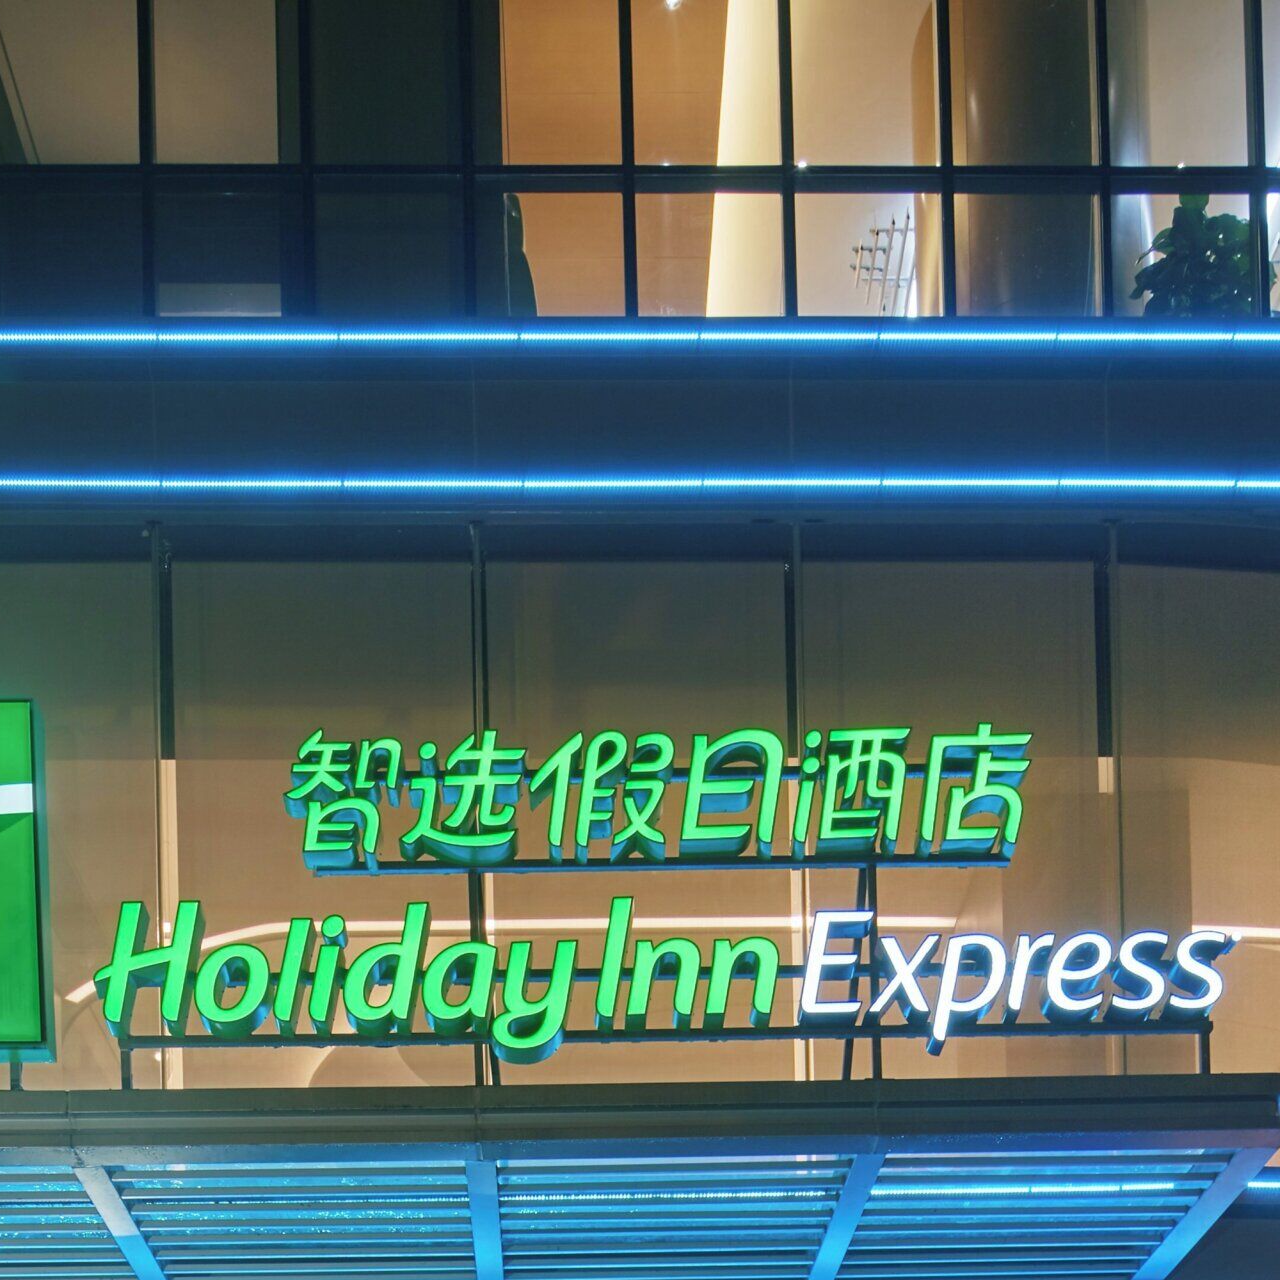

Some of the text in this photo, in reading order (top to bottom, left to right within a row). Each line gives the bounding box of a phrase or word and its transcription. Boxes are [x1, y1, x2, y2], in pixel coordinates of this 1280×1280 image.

[290, 724, 1031, 852] 智选假日酒店
[94, 895, 1226, 1049] Holiday Inn Express
